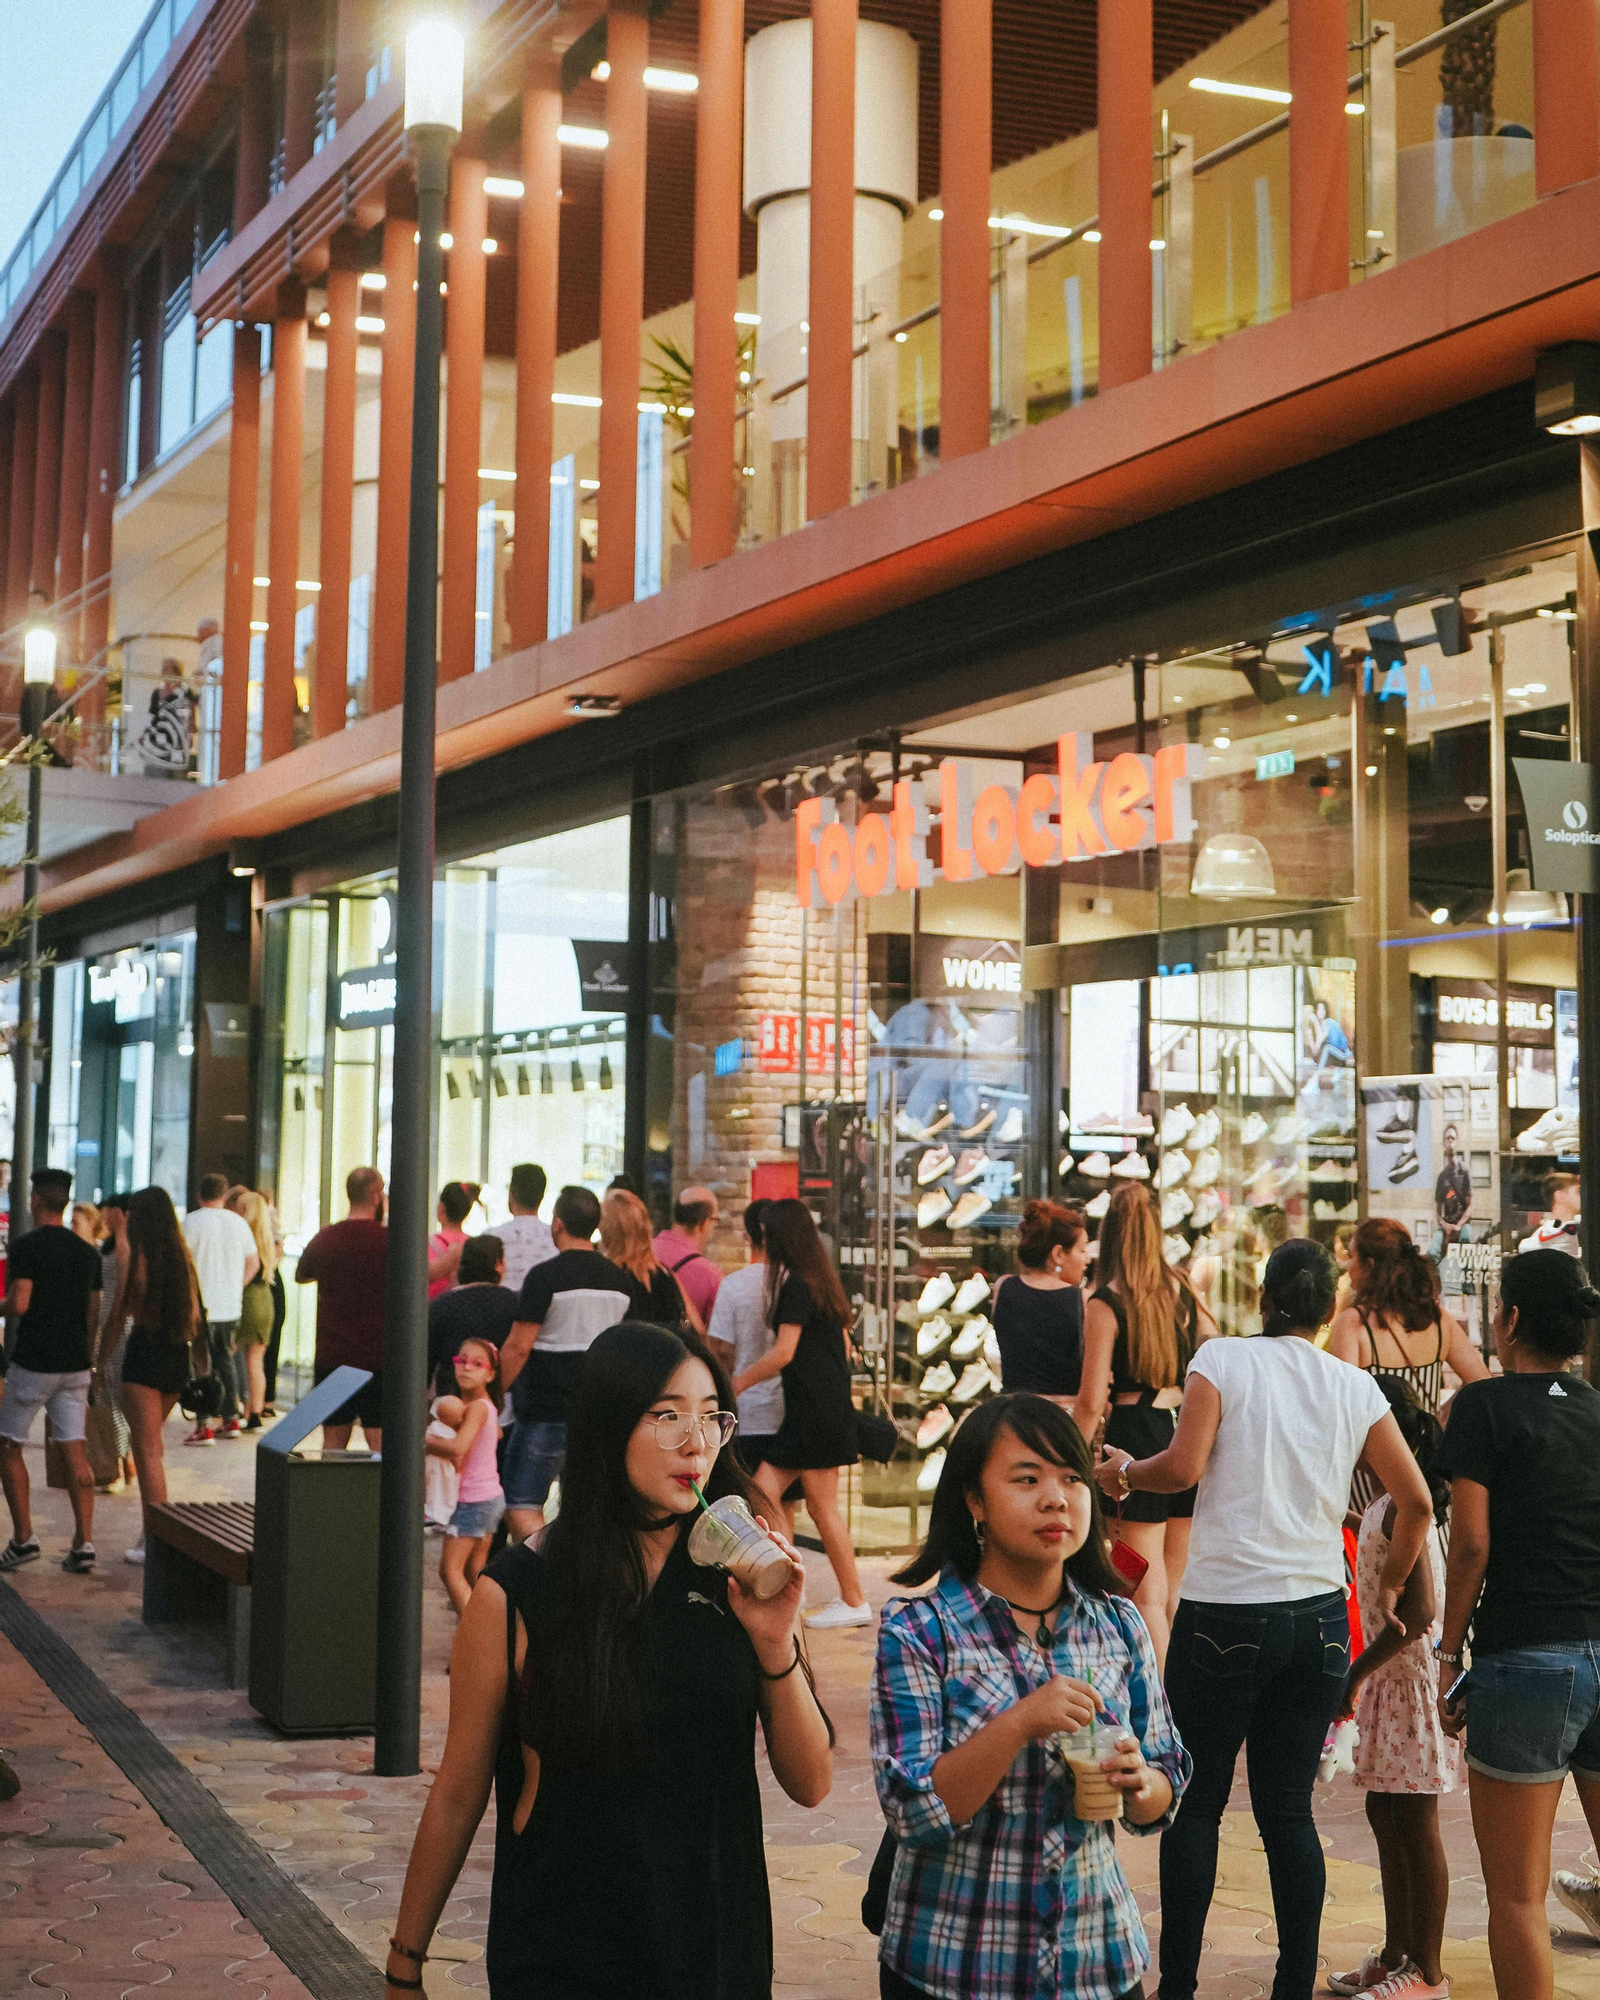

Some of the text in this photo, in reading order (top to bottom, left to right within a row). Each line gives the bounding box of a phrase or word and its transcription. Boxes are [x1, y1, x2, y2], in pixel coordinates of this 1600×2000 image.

[796, 731, 1192, 909] Foot Locker
[942, 957, 1022, 993] WOME
[1438, 995, 1486, 1026] BOYS
[1444, 1269, 1500, 1286] CLASSICS
